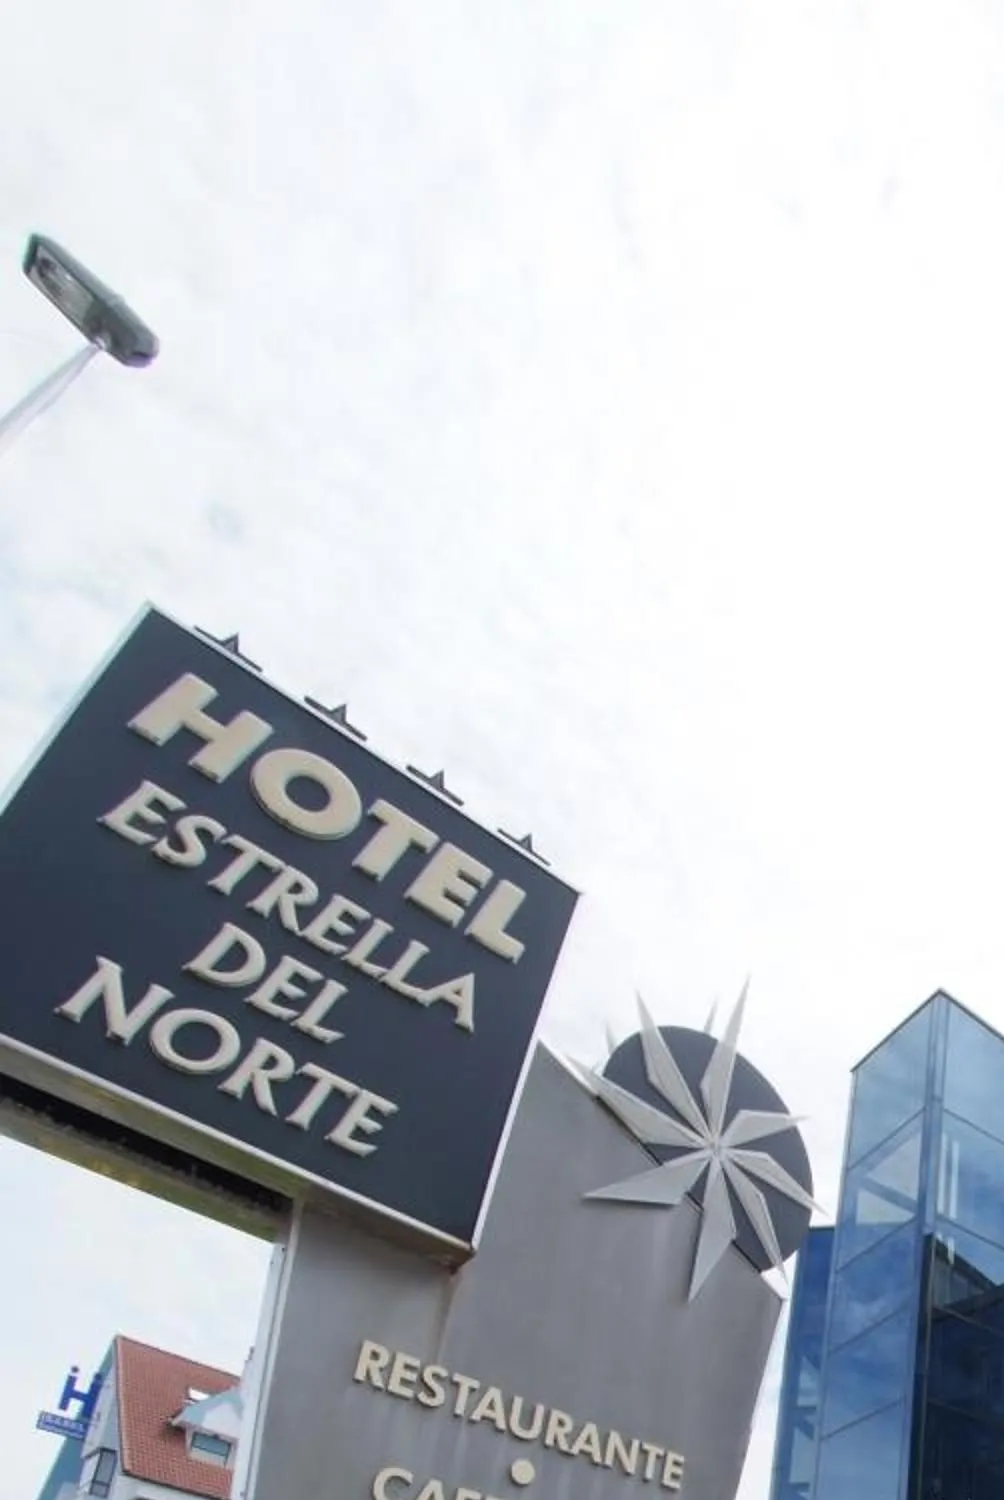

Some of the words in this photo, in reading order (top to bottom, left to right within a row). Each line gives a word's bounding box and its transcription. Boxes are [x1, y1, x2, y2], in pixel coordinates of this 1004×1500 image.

[97, 780, 475, 1034] ESTRELLA
[127, 672, 526, 964] HOTEL
[55, 956, 399, 1157] NORTE
[183, 923, 348, 1042] DEL
[353, 1340, 685, 1490] RESTAURANTE
